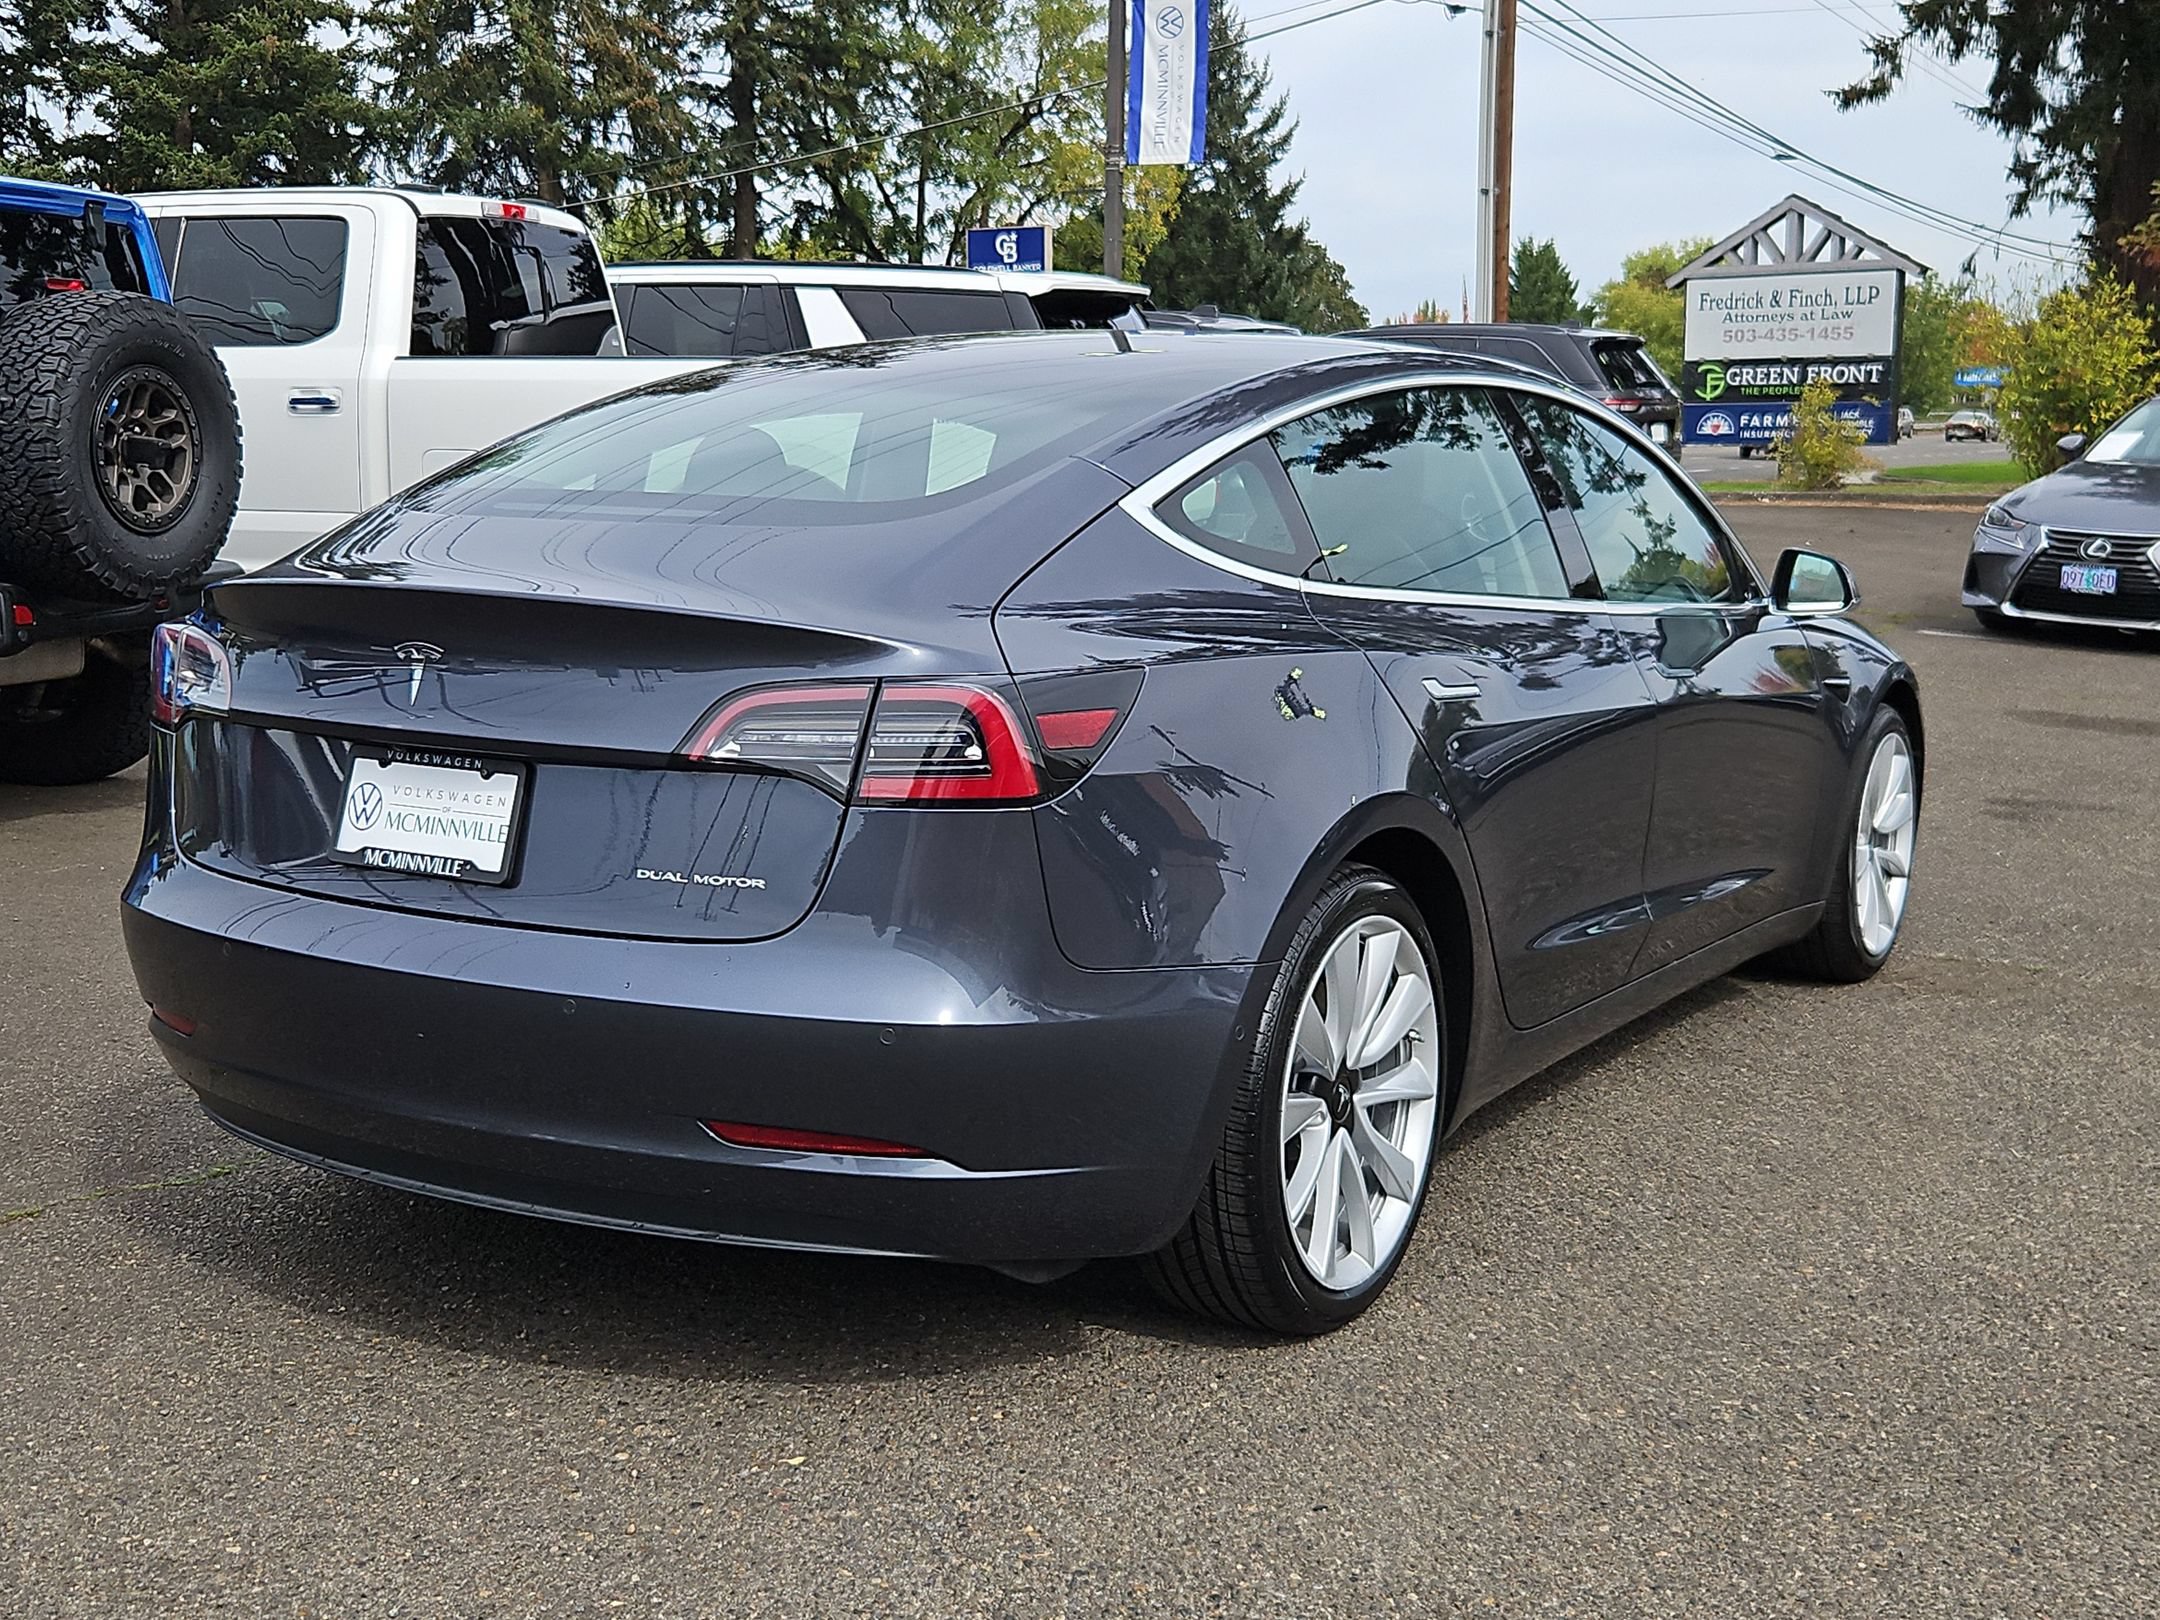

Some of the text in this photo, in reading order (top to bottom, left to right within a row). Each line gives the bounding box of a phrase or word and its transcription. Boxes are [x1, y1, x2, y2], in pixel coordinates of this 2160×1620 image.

[1153, 44, 1169, 149] MCMINNVILLE
[1699, 285, 1881, 312] Fredrick & Finch, LLP
[1722, 308, 1854, 325] Attorneys at Law
[1722, 326, 1855, 344] 503-435-1455
[1726, 363, 1885, 386] GREEN FRONT
[1741, 386, 1803, 396] THE PEOPLE
[386, 750, 483, 769] VOLKSWAGEN
[392, 784, 507, 808] VOLKSWAGEN
[441, 806, 452, 814] OF
[384, 811, 510, 844] MCMINNVILLE
[364, 848, 464, 877] MCMINNVILLE
[636, 869, 767, 889] DUAL MOTOR
